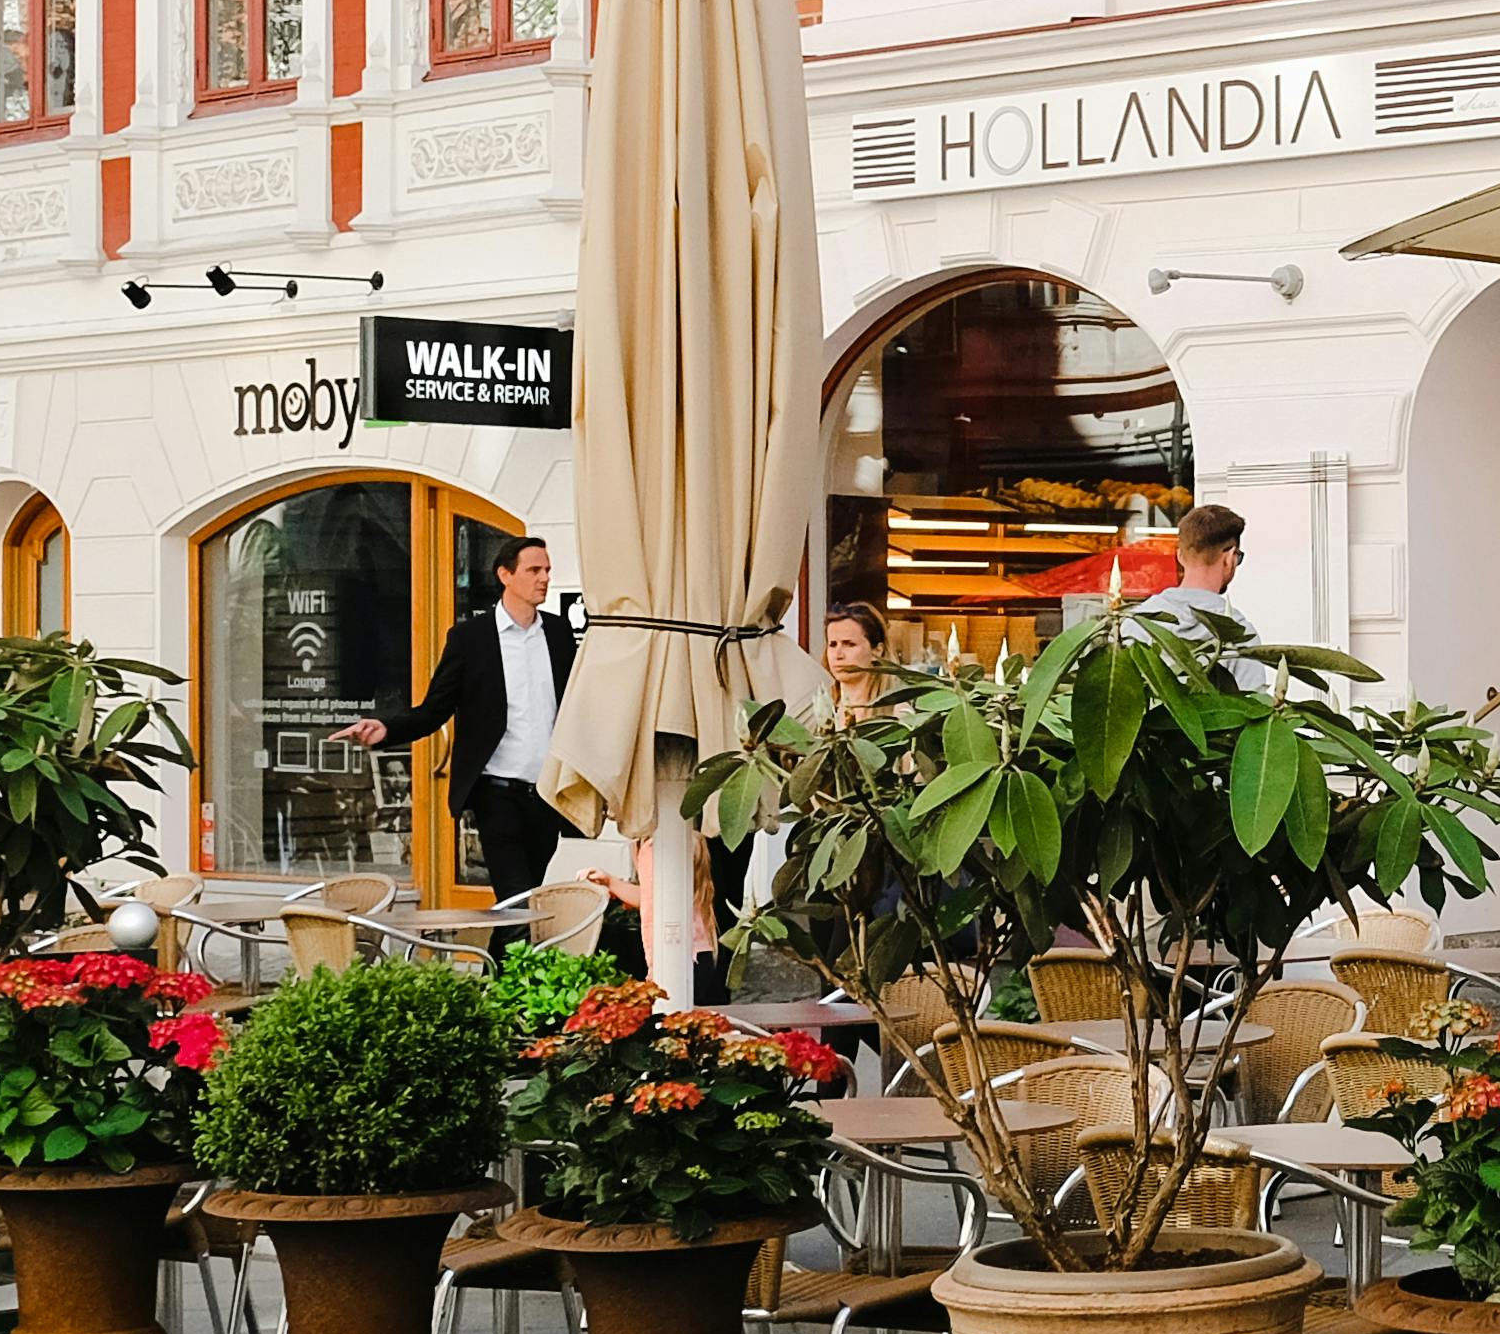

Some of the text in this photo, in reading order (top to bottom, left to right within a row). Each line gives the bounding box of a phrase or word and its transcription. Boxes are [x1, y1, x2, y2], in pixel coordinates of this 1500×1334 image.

[940, 69, 1343, 182] HOLLANDIA
[405, 340, 551, 383] WALK-IN
[234, 358, 360, 450] moby
[405, 379, 550, 406] SERVICE & REPAIR
[287, 590, 327, 614] WiFi
[287, 675, 327, 692] Lounge
